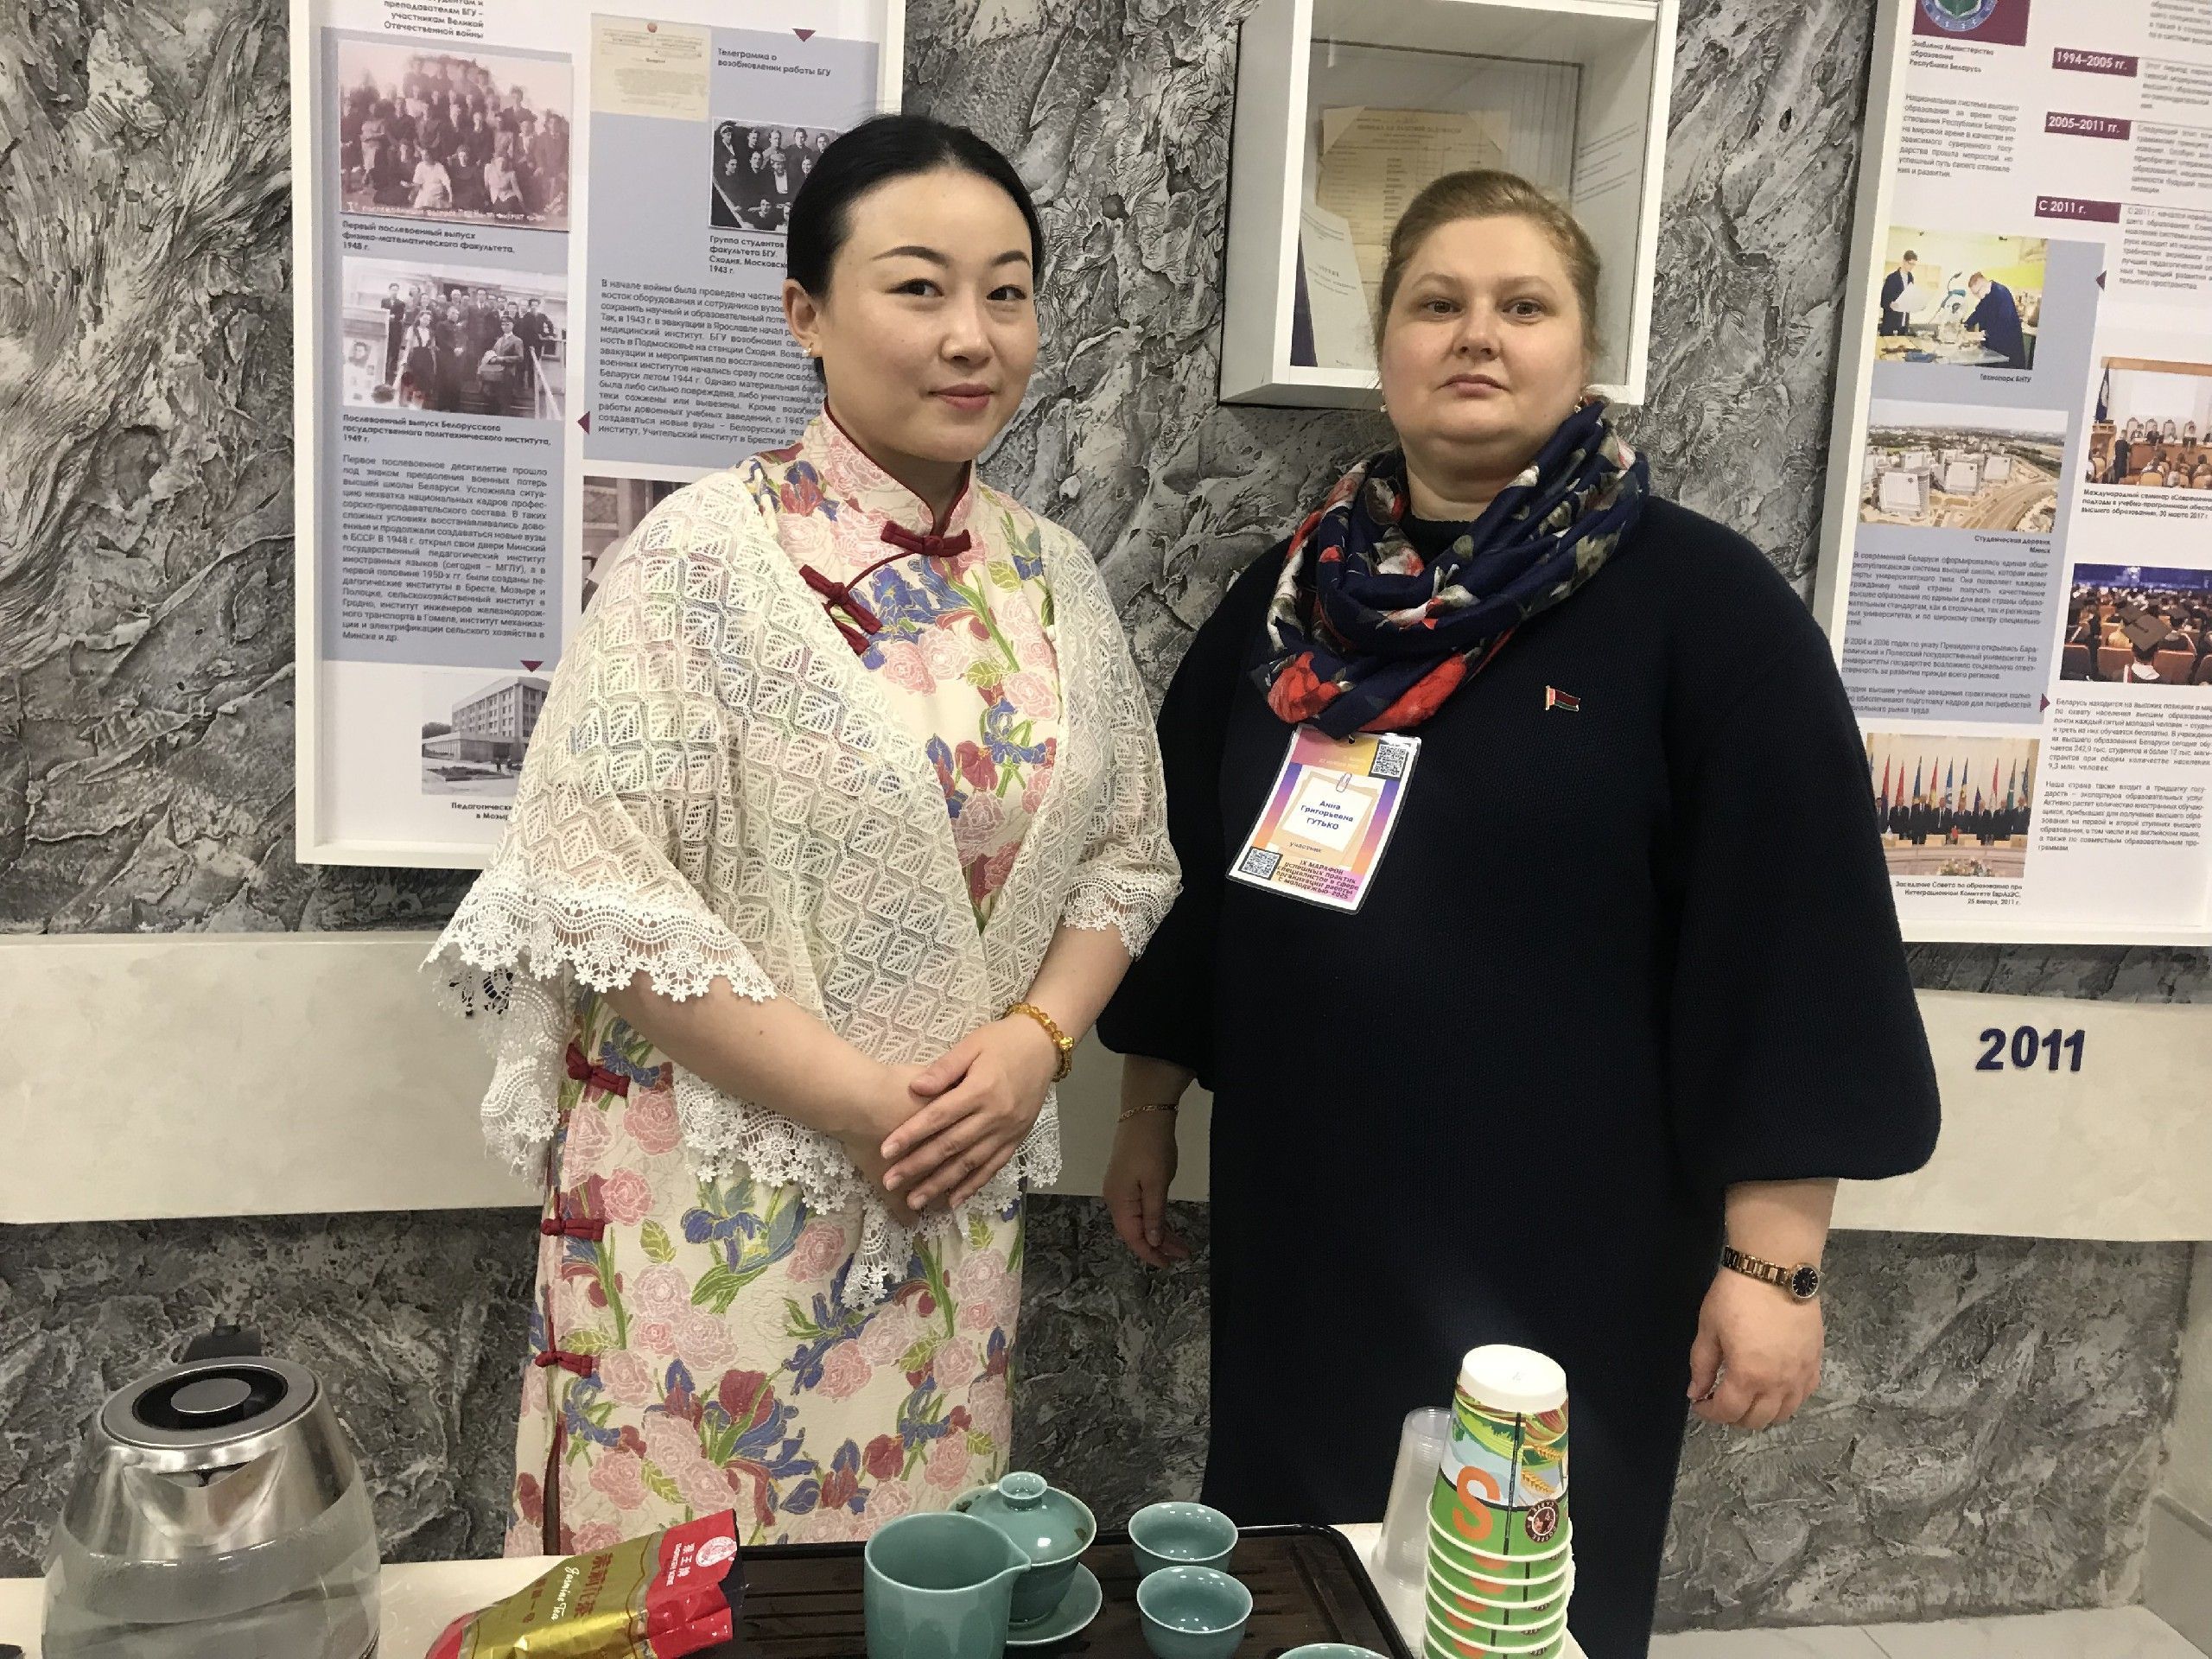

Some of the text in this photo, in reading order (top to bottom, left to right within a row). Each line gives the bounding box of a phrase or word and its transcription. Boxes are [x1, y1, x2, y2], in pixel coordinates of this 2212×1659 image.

[718, 47, 769, 60] Телеграмма
[717, 59, 830, 76] возобновлении работы БГУ
[342, 220, 475, 240] Первый послевоенный выпуск
[342, 230, 458, 248] физико-математического
[343, 242, 362, 250] 1948
[709, 234, 786, 248] Группа студентов
[709, 245, 760, 255] факультета
[709, 263, 727, 272] 1943
[601, 278, 745, 298] В начале войны была проведена
[633, 294, 695, 305] оборудования
[705, 301, 759, 311] сотрудников
[600, 303, 644, 312] сохранить
[645, 307, 682, 315] научный
[690, 308, 766, 321] образовательный
[634, 337, 694, 350] Подмосковье
[707, 345, 743, 355] станции
[744, 346, 775, 357] Сходня
[600, 348, 646, 358] эвакуации
[656, 352, 713, 362] мероприятия
[728, 358, 803, 369] восстановлению
[343, 413, 500, 432] Послевоенный выпуск Белорусского
[342, 425, 422, 436] государственного
[424, 430, 502, 441] политехнического
[343, 432, 362, 441] 1949
[342, 454, 375, 464] Первое
[381, 459, 445, 468] послевоенное
[451, 463, 507, 473] десятилетие
[343, 468, 359, 476] под
[406, 472, 464, 481] преодоления
[516, 479, 547, 488] потерь
[408, 494, 473, 504] национальных
[476, 498, 508, 507] кадров
[511, 500, 546, 509] профес-
[342, 578, 402, 587] дагогические
[405, 582, 452, 591] институты
[500, 585, 536, 596] Мозыре
[1300, 805, 1354, 823] Григорьевна
[1320, 801, 1341, 810] Анна
[1306, 817, 1339, 830] ГУТЬКО
[1289, 842, 1322, 853] участник
[1308, 863, 1343, 874] МАРАФОН
[1976, 1025, 2085, 1072] 2011
[550, 1567, 580, 1621] Jasmine Tea
